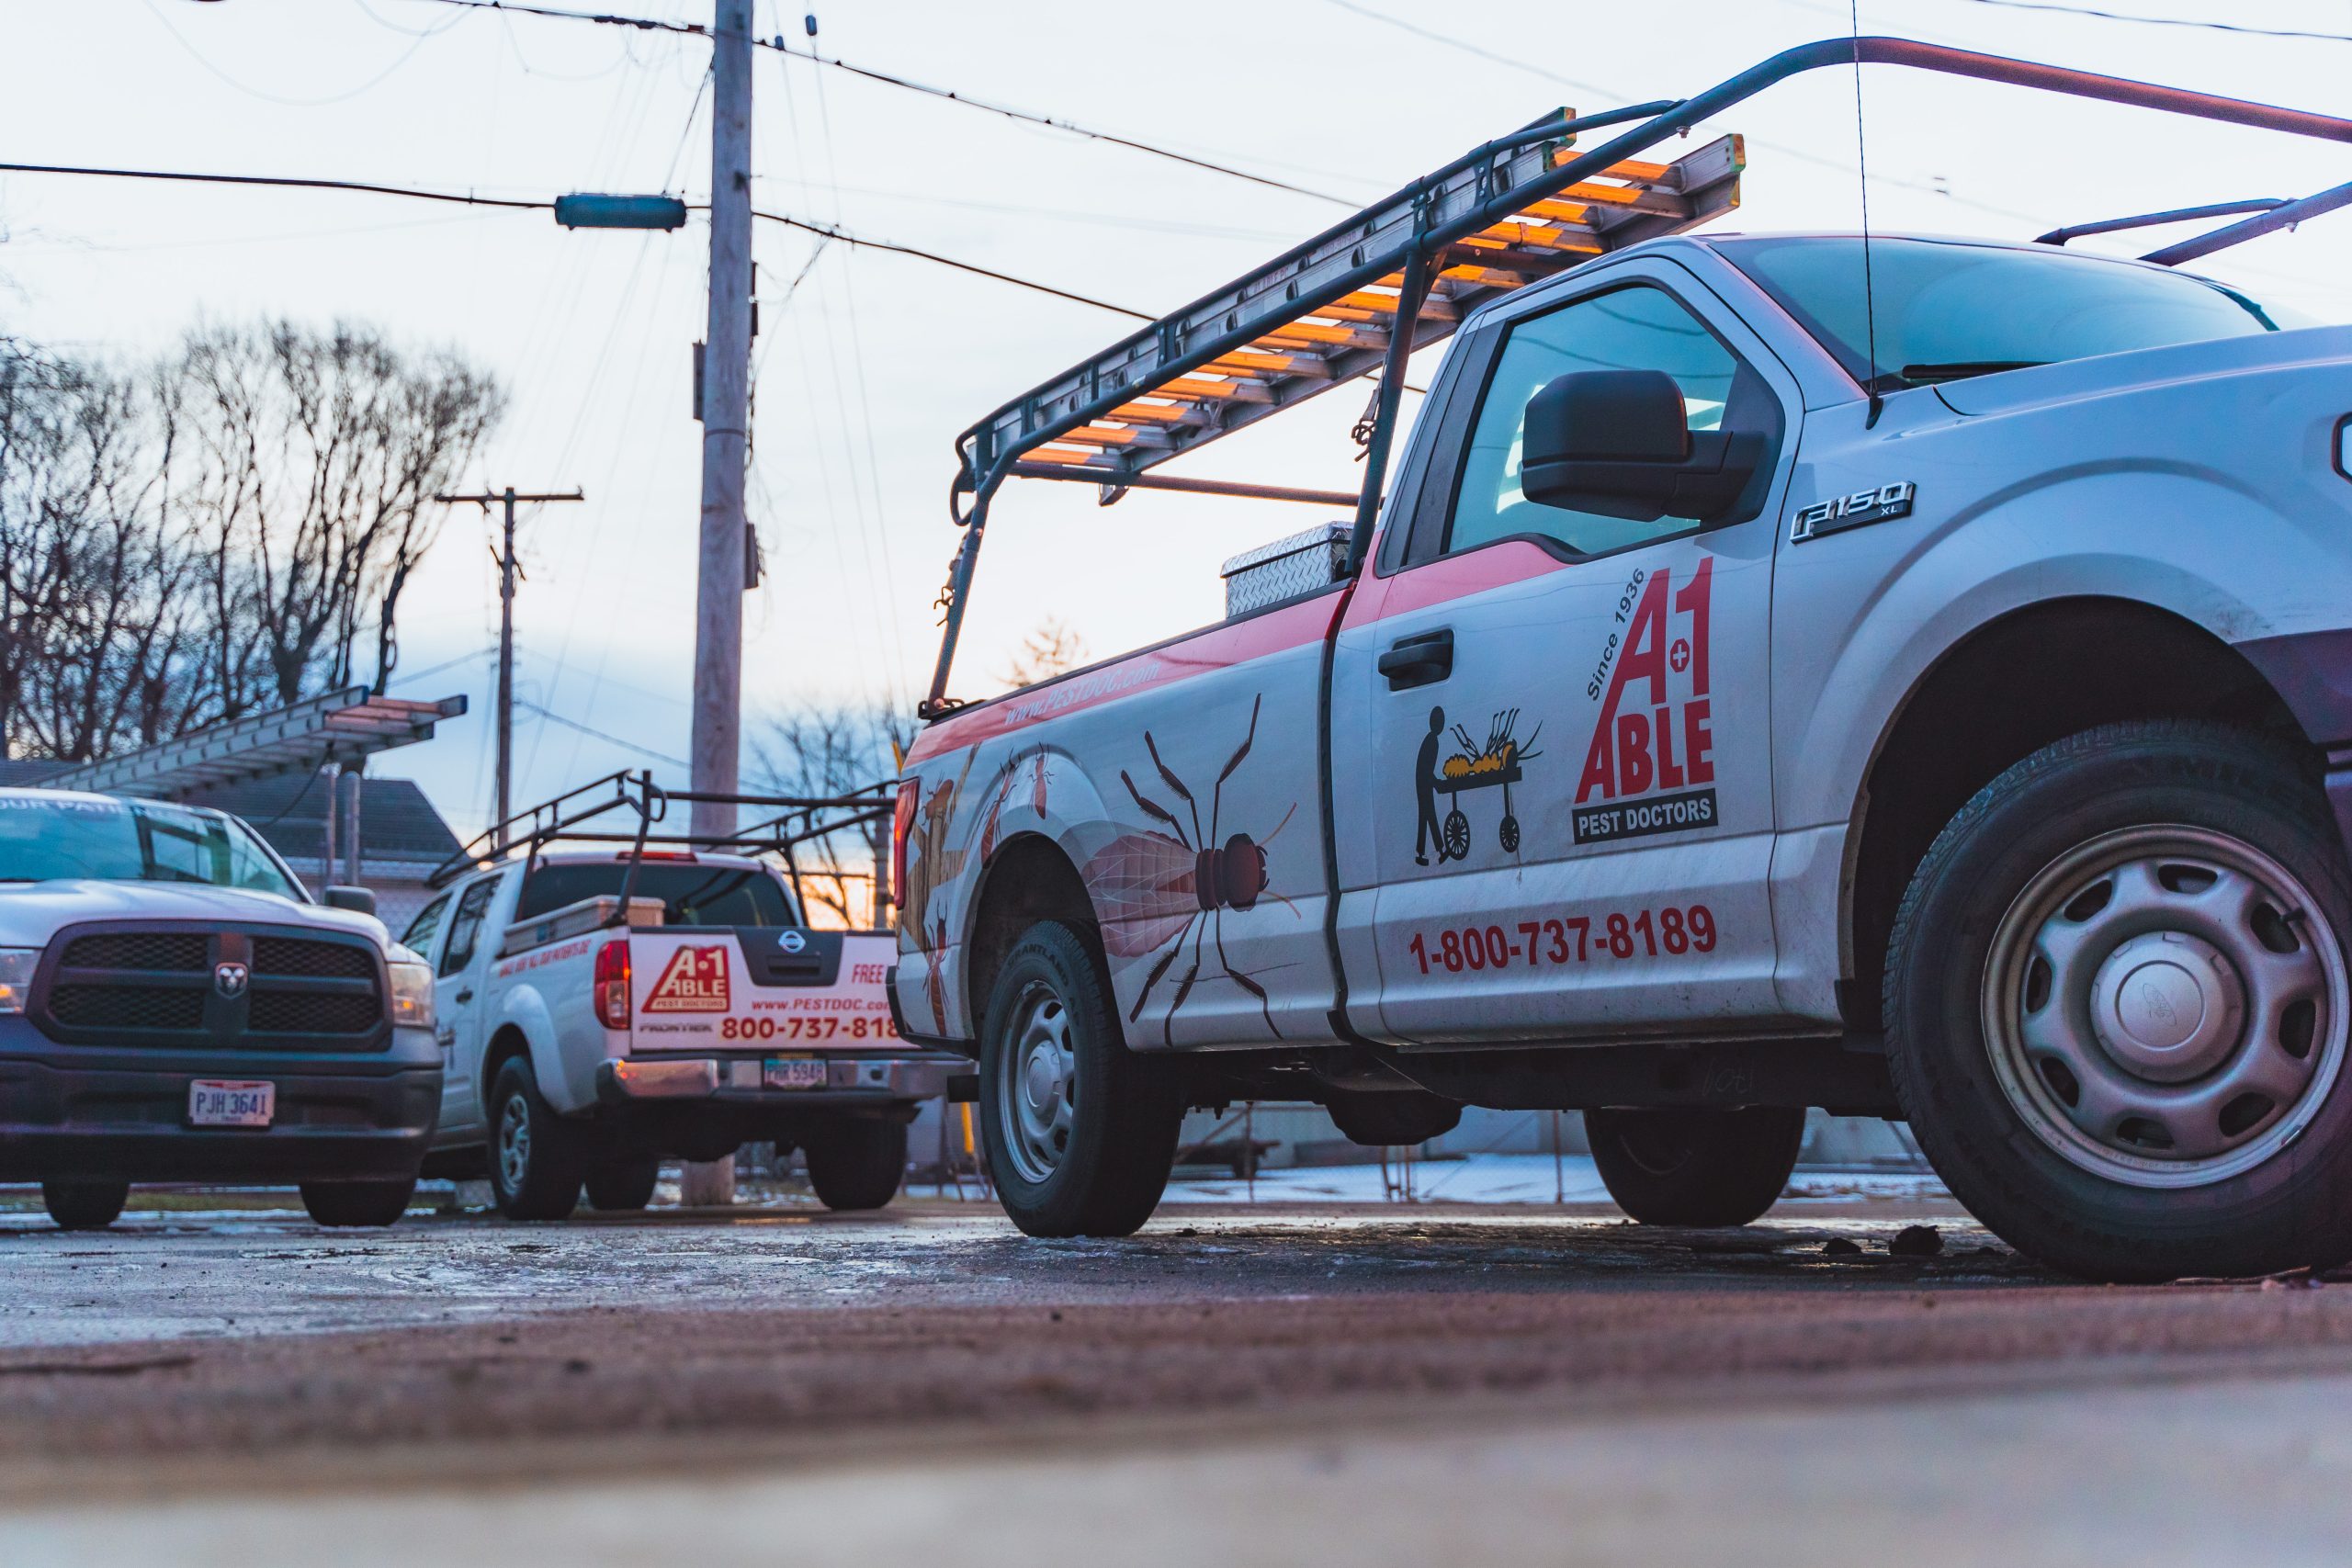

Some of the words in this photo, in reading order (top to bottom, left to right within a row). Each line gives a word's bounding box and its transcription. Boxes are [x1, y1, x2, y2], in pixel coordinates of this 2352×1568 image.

[1881, 505, 1897, 516] XL
[1587, 632, 1619, 702] Since
[1614, 567, 1645, 626] 1936
[1003, 662, 1160, 727] www.PESTDOC.com
[1574, 698, 1715, 804] ABLE
[1578, 809, 1620, 838] PEST
[1626, 797, 1712, 829] DOCTORS
[1409, 905, 1717, 976] 1-800-737-8189
[658, 978, 726, 997] ABLE
[852, 964, 884, 984] FREE
[197, 1091, 225, 1114] PJH
[230, 1093, 266, 1115] 3641
